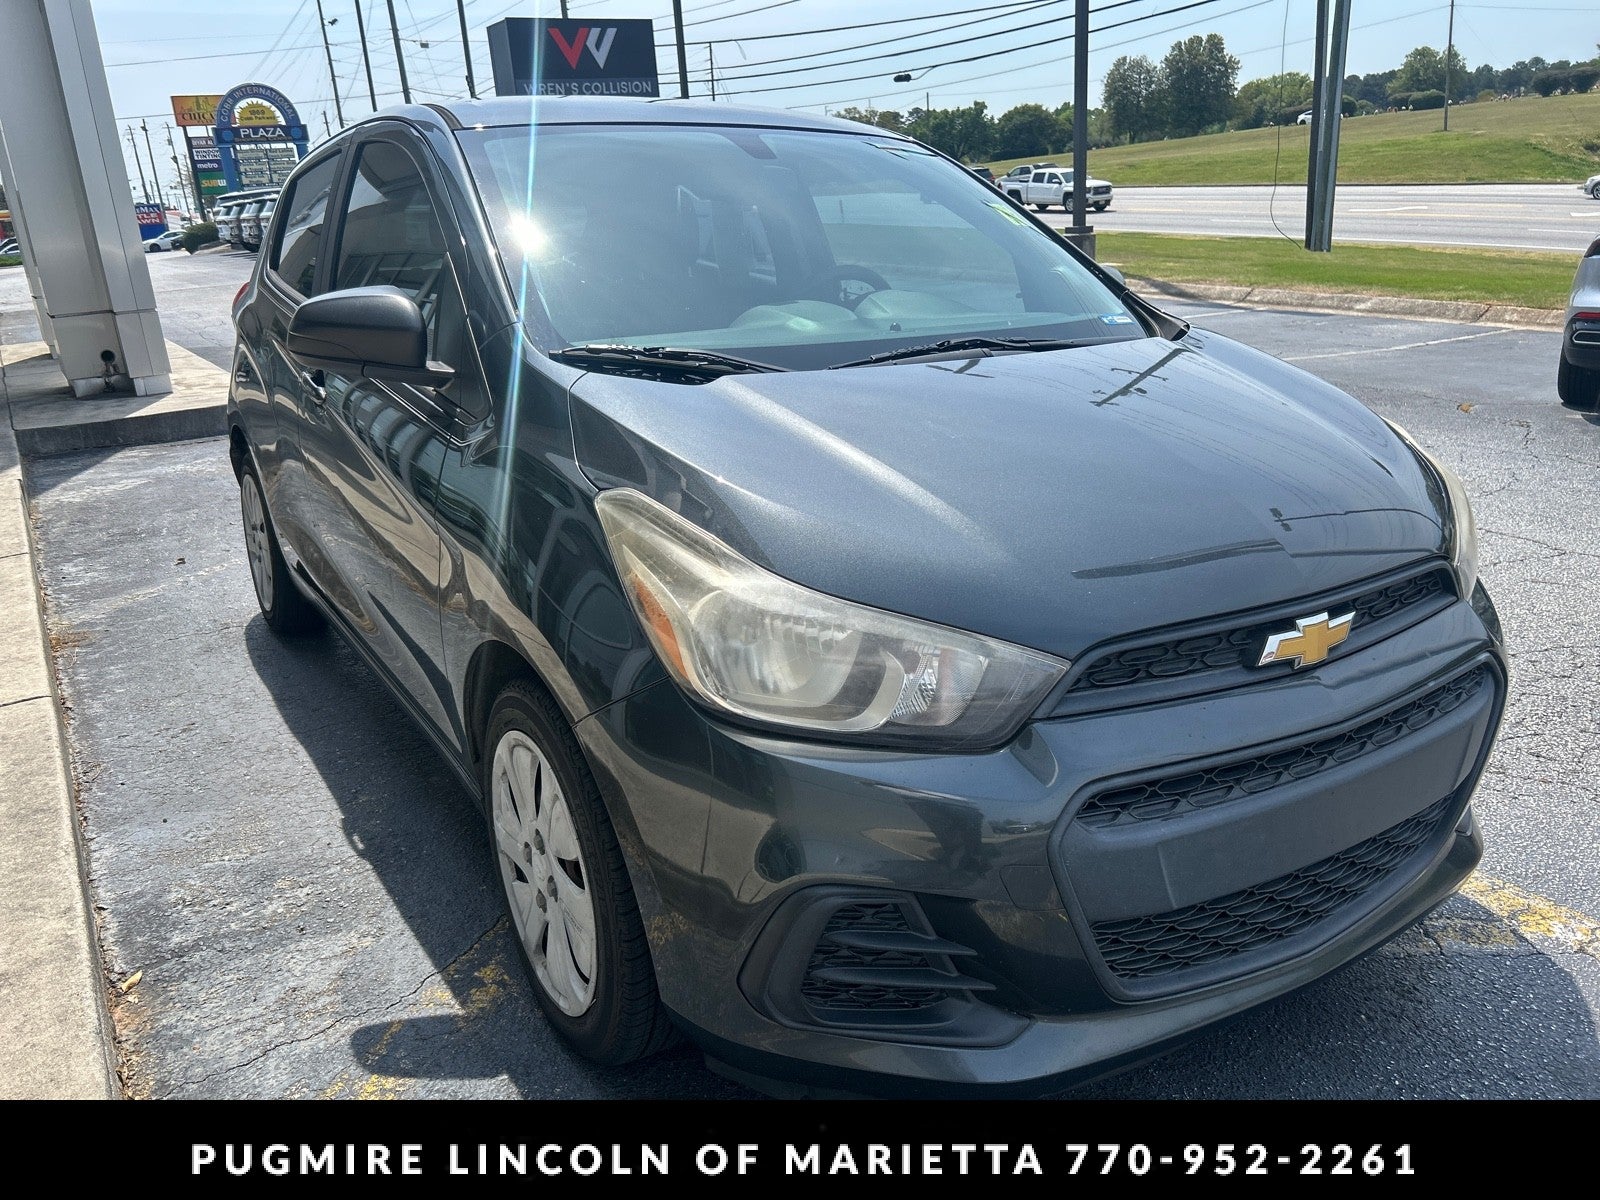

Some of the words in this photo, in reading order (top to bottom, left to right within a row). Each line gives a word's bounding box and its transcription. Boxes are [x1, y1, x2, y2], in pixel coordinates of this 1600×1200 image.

[583, 81, 652, 95] COLLISION
[221, 98, 233, 122] COBB
[233, 86, 295, 119] INTERNATIONAL
[240, 127, 285, 138] PLAZA
[202, 179, 227, 187] SUBW
